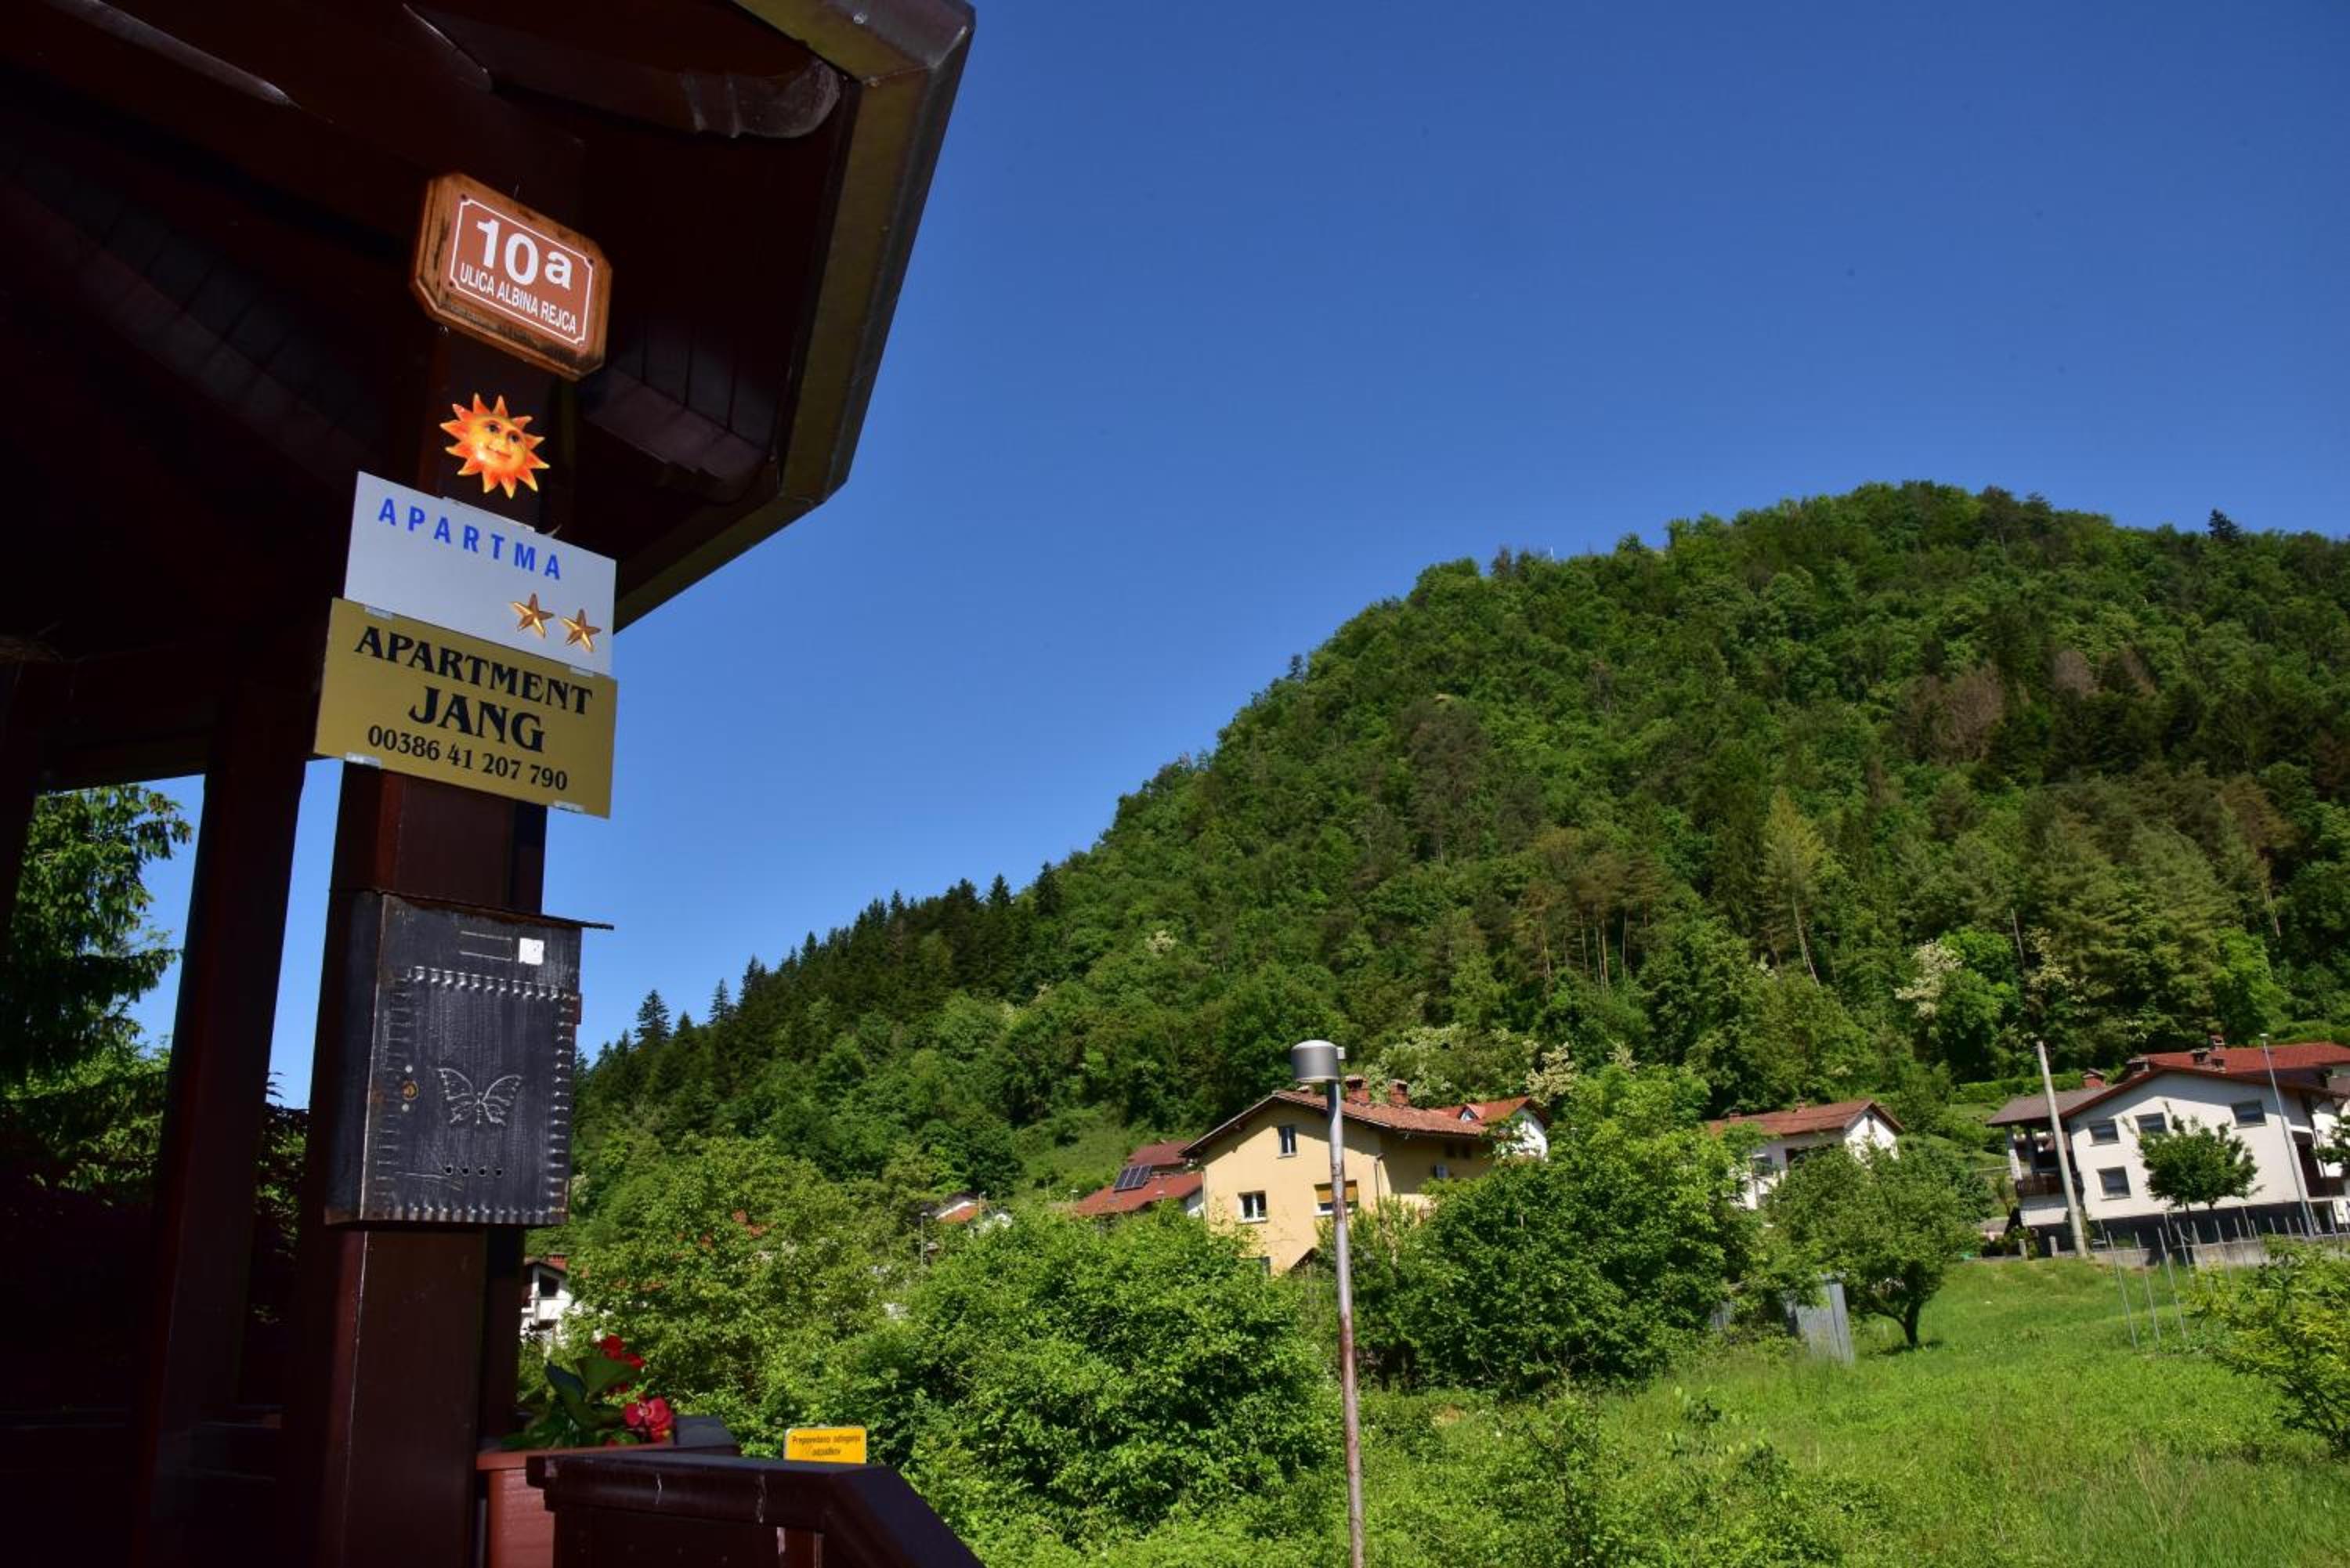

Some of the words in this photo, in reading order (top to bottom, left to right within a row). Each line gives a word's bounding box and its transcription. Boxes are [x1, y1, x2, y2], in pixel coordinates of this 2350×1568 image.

[460, 262, 494, 296] ULICA
[497, 282, 538, 316] ALBINA
[540, 301, 577, 334] REJCA
[378, 497, 561, 580] APARTMA
[354, 626, 593, 715] APARTMENT
[408, 685, 545, 753] JANG
[367, 725, 440, 761] 00386
[446, 743, 473, 771] 41
[482, 753, 522, 780] 207
[530, 764, 568, 791] 790
